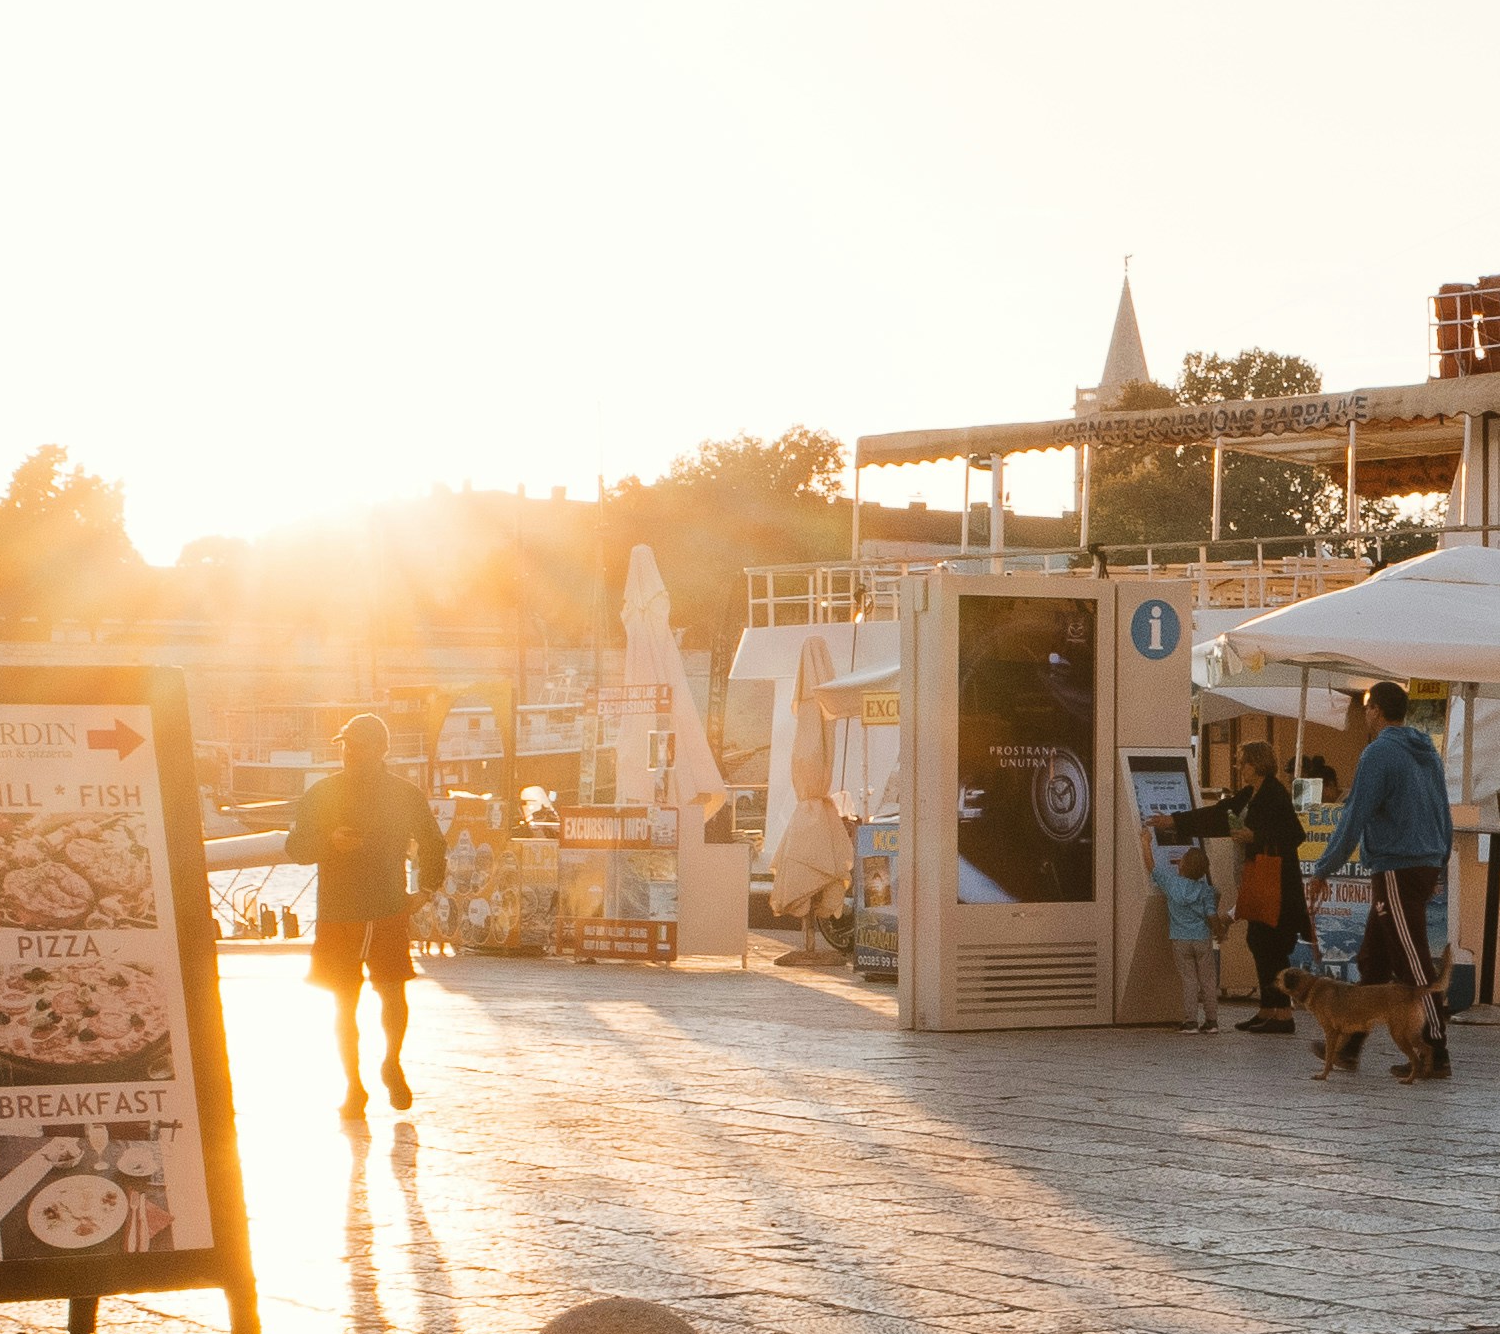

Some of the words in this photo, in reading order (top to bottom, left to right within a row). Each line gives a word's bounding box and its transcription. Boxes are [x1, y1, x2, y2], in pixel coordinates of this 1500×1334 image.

[16, 749, 25, 759] &
[29, 750, 73, 761] pizzeria
[990, 746, 1057, 756] PROSTRANA
[1000, 759, 1047, 768] UNUTRA
[79, 784, 142, 807] FISH
[565, 818, 621, 840] EXCURSION
[625, 818, 649, 840] INFO
[18, 935, 100, 958] PIZZA
